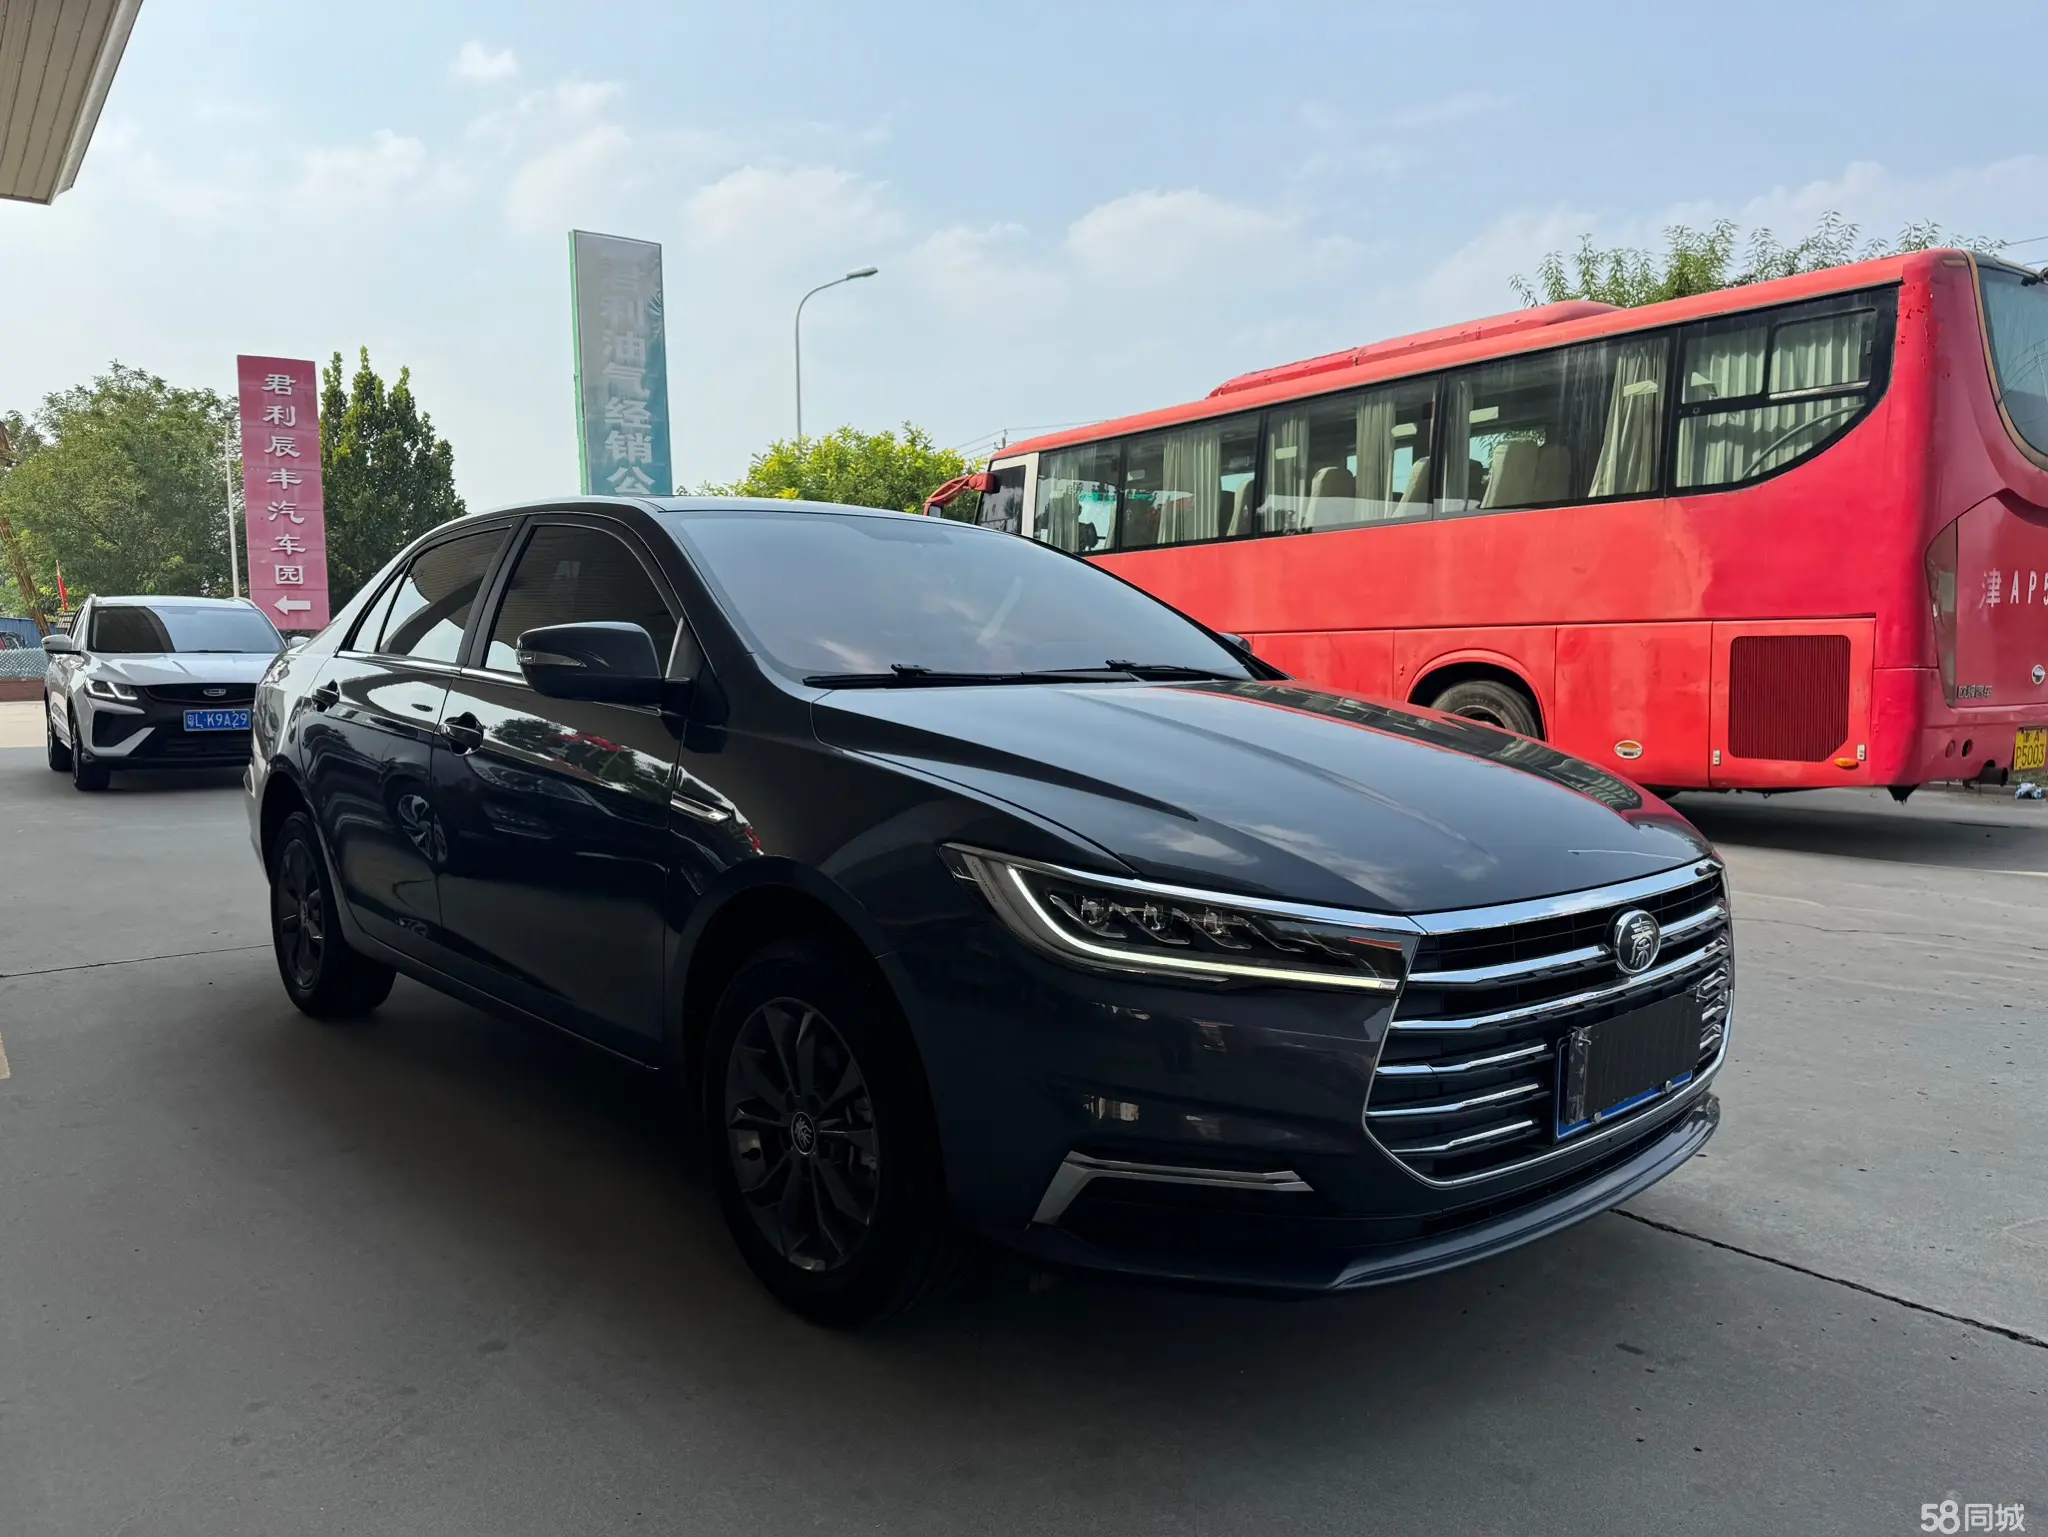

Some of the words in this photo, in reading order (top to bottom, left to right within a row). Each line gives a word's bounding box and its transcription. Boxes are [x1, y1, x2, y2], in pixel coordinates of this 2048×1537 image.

[261, 373, 306, 585] 君利辰丰汽车园
[2015, 743, 2045, 768] P5003
